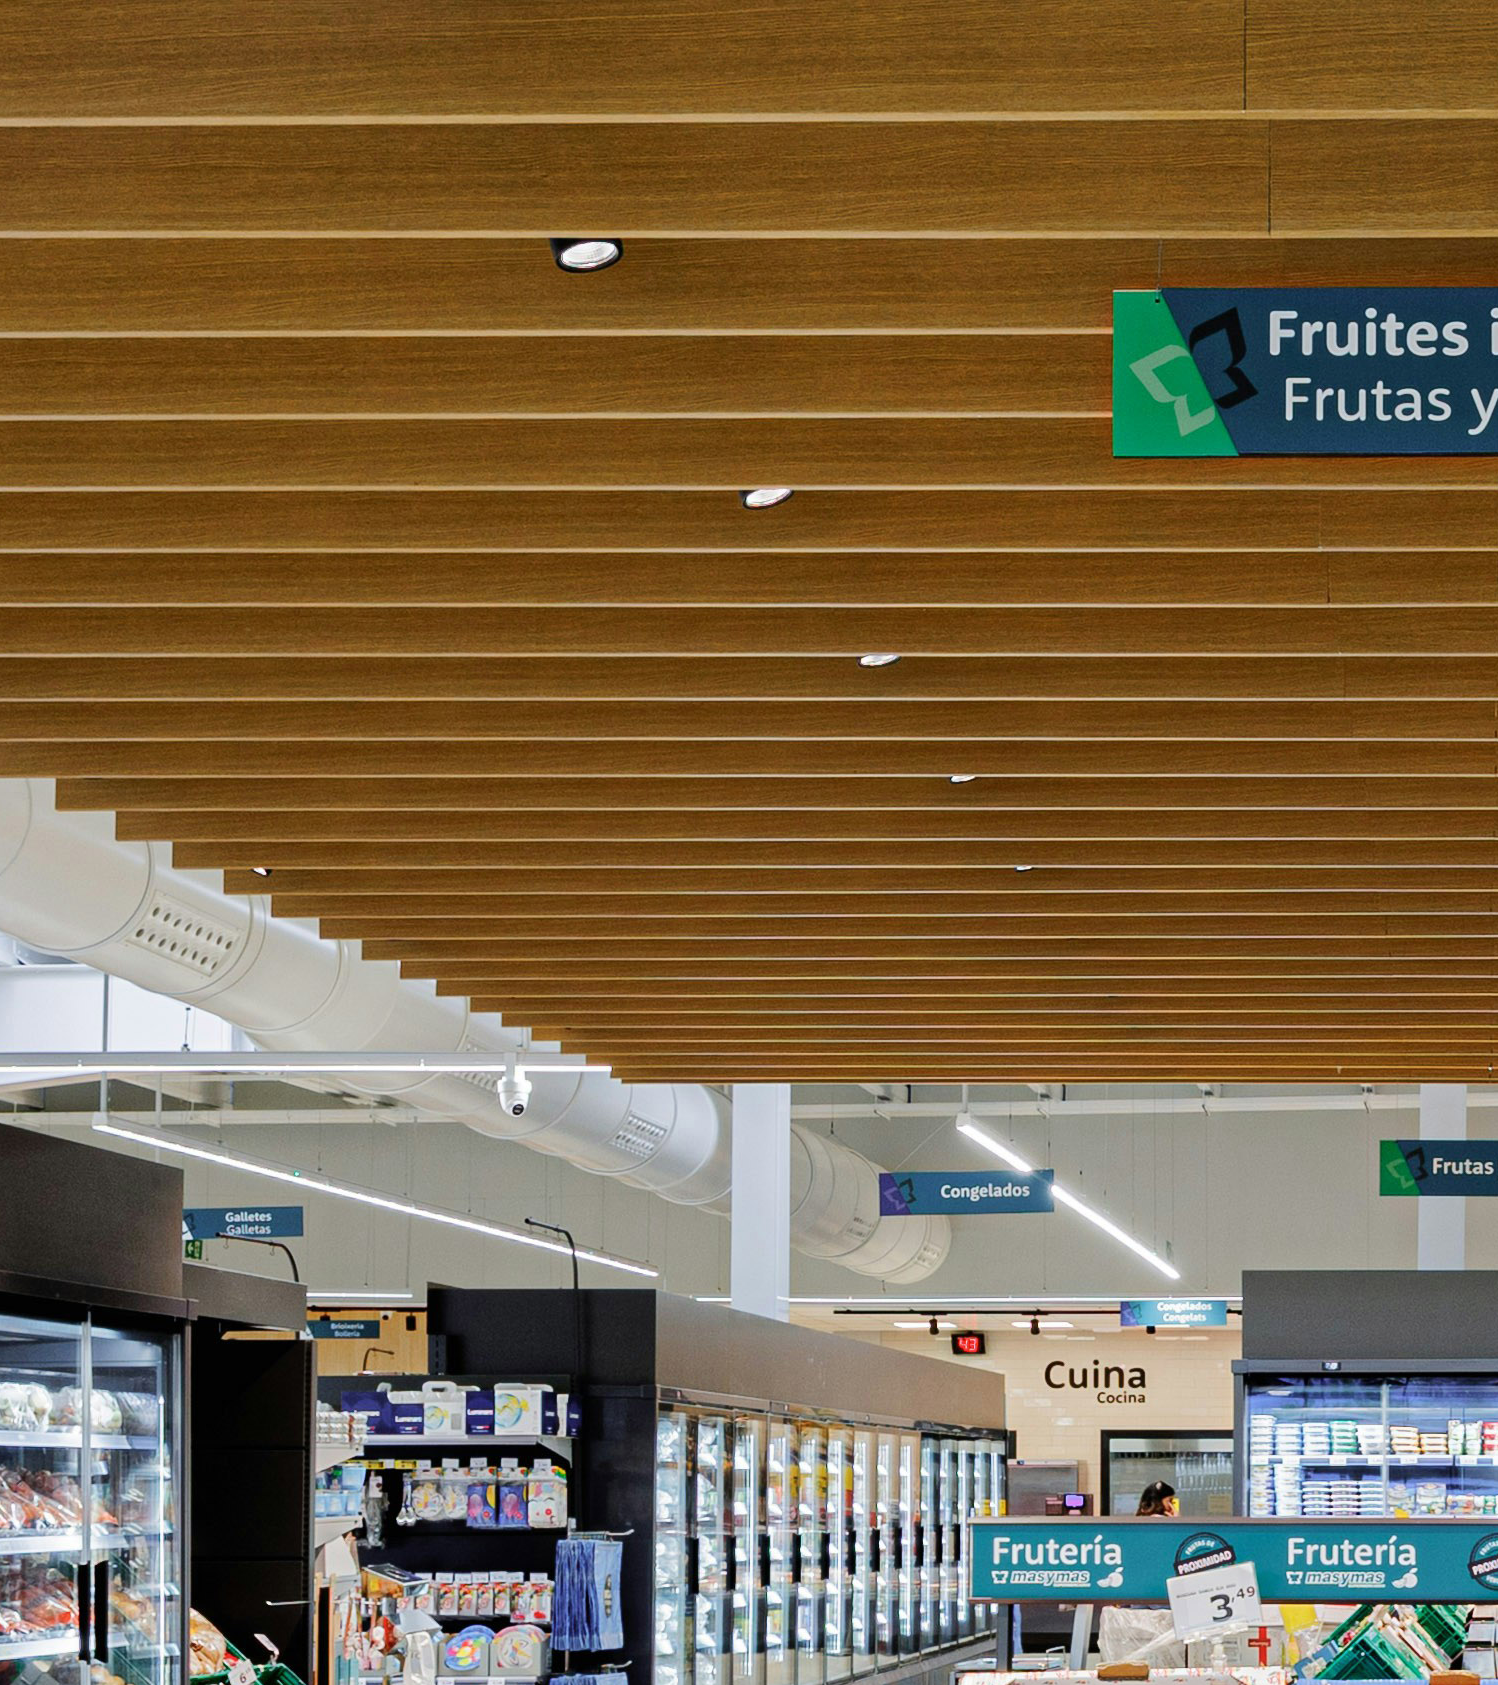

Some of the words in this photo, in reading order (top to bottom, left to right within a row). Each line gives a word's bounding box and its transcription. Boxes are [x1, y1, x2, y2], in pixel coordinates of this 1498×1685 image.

[1269, 308, 1469, 357] Fruites
[1283, 378, 1452, 421] Frutas
[1432, 1156, 1494, 1178] Frutas
[940, 1182, 1030, 1202] Congelados
[225, 1211, 272, 1223] Galletes
[226, 1224, 271, 1236] Galletas
[1157, 1301, 1212, 1312] Congelados
[1163, 1312, 1206, 1323] Congelats
[957, 1337, 978, 1352] 43
[1044, 1359, 1147, 1389] Cuina
[1097, 1391, 1146, 1404] Cocina
[992, 1534, 1122, 1567] Frutería
[1287, 1535, 1417, 1567] Frutería
[1178, 1550, 1232, 1575] PROXIMIDAD
[1011, 1570, 1091, 1588] masymas
[1305, 1571, 1385, 1588] masymas
[1210, 1586, 1256, 1622] 3,49
